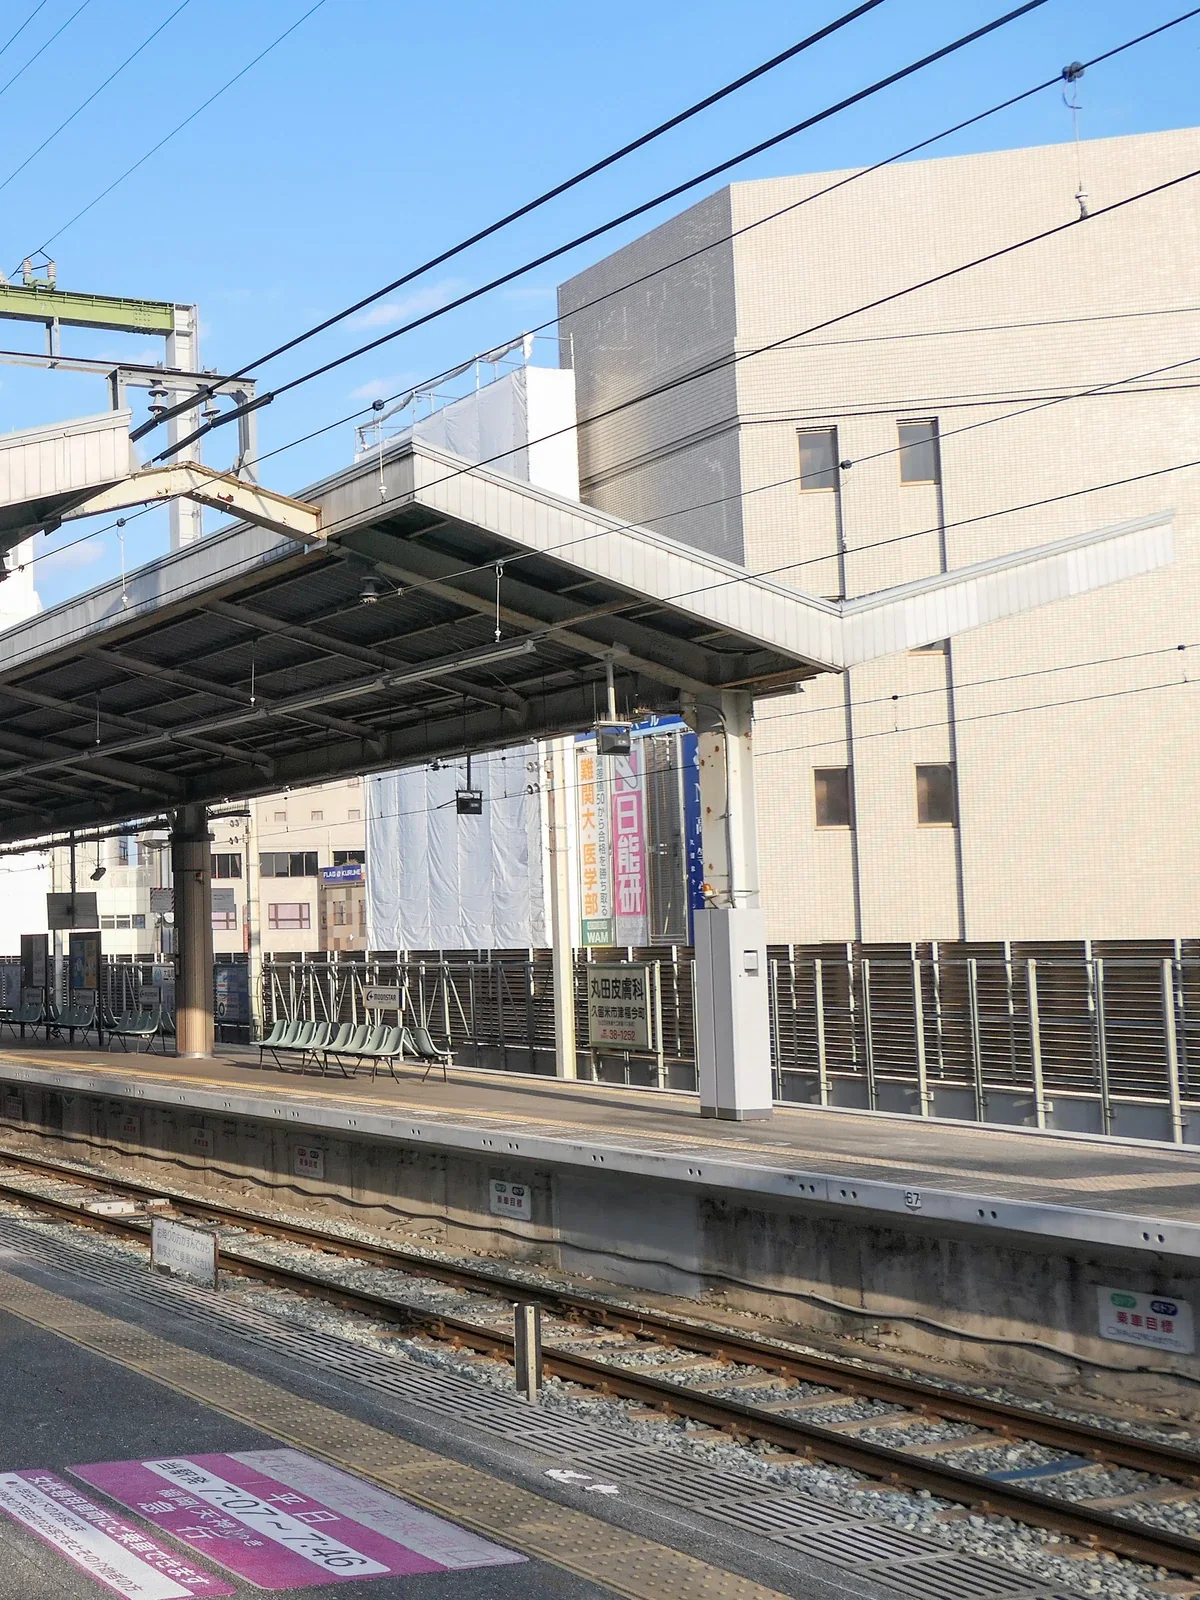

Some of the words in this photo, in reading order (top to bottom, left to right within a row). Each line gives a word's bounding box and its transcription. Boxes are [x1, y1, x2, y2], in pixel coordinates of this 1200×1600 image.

[616, 794, 643, 914] 日能研
[586, 931, 609, 943] WAM
[591, 977, 644, 1001] 丸田皮膚科
[591, 1005, 645, 1019] 久留米市津福今町
[610, 1029, 636, 1041] 38-1252
[905, 1192, 921, 1205] 67
[1116, 1311, 1174, 1334] 乗車目標
[136, 1500, 227, 1539] 急行
[155, 1461, 209, 1485] 当駅発
[198, 1485, 278, 1516] 7:07
[282, 1532, 367, 1567] 7:46
[156, 1488, 262, 1546] 福岡(天神)ゆき
[266, 1491, 340, 1523] 平日
[31, 1476, 208, 1584] 女性専用車両にご乗車できます
